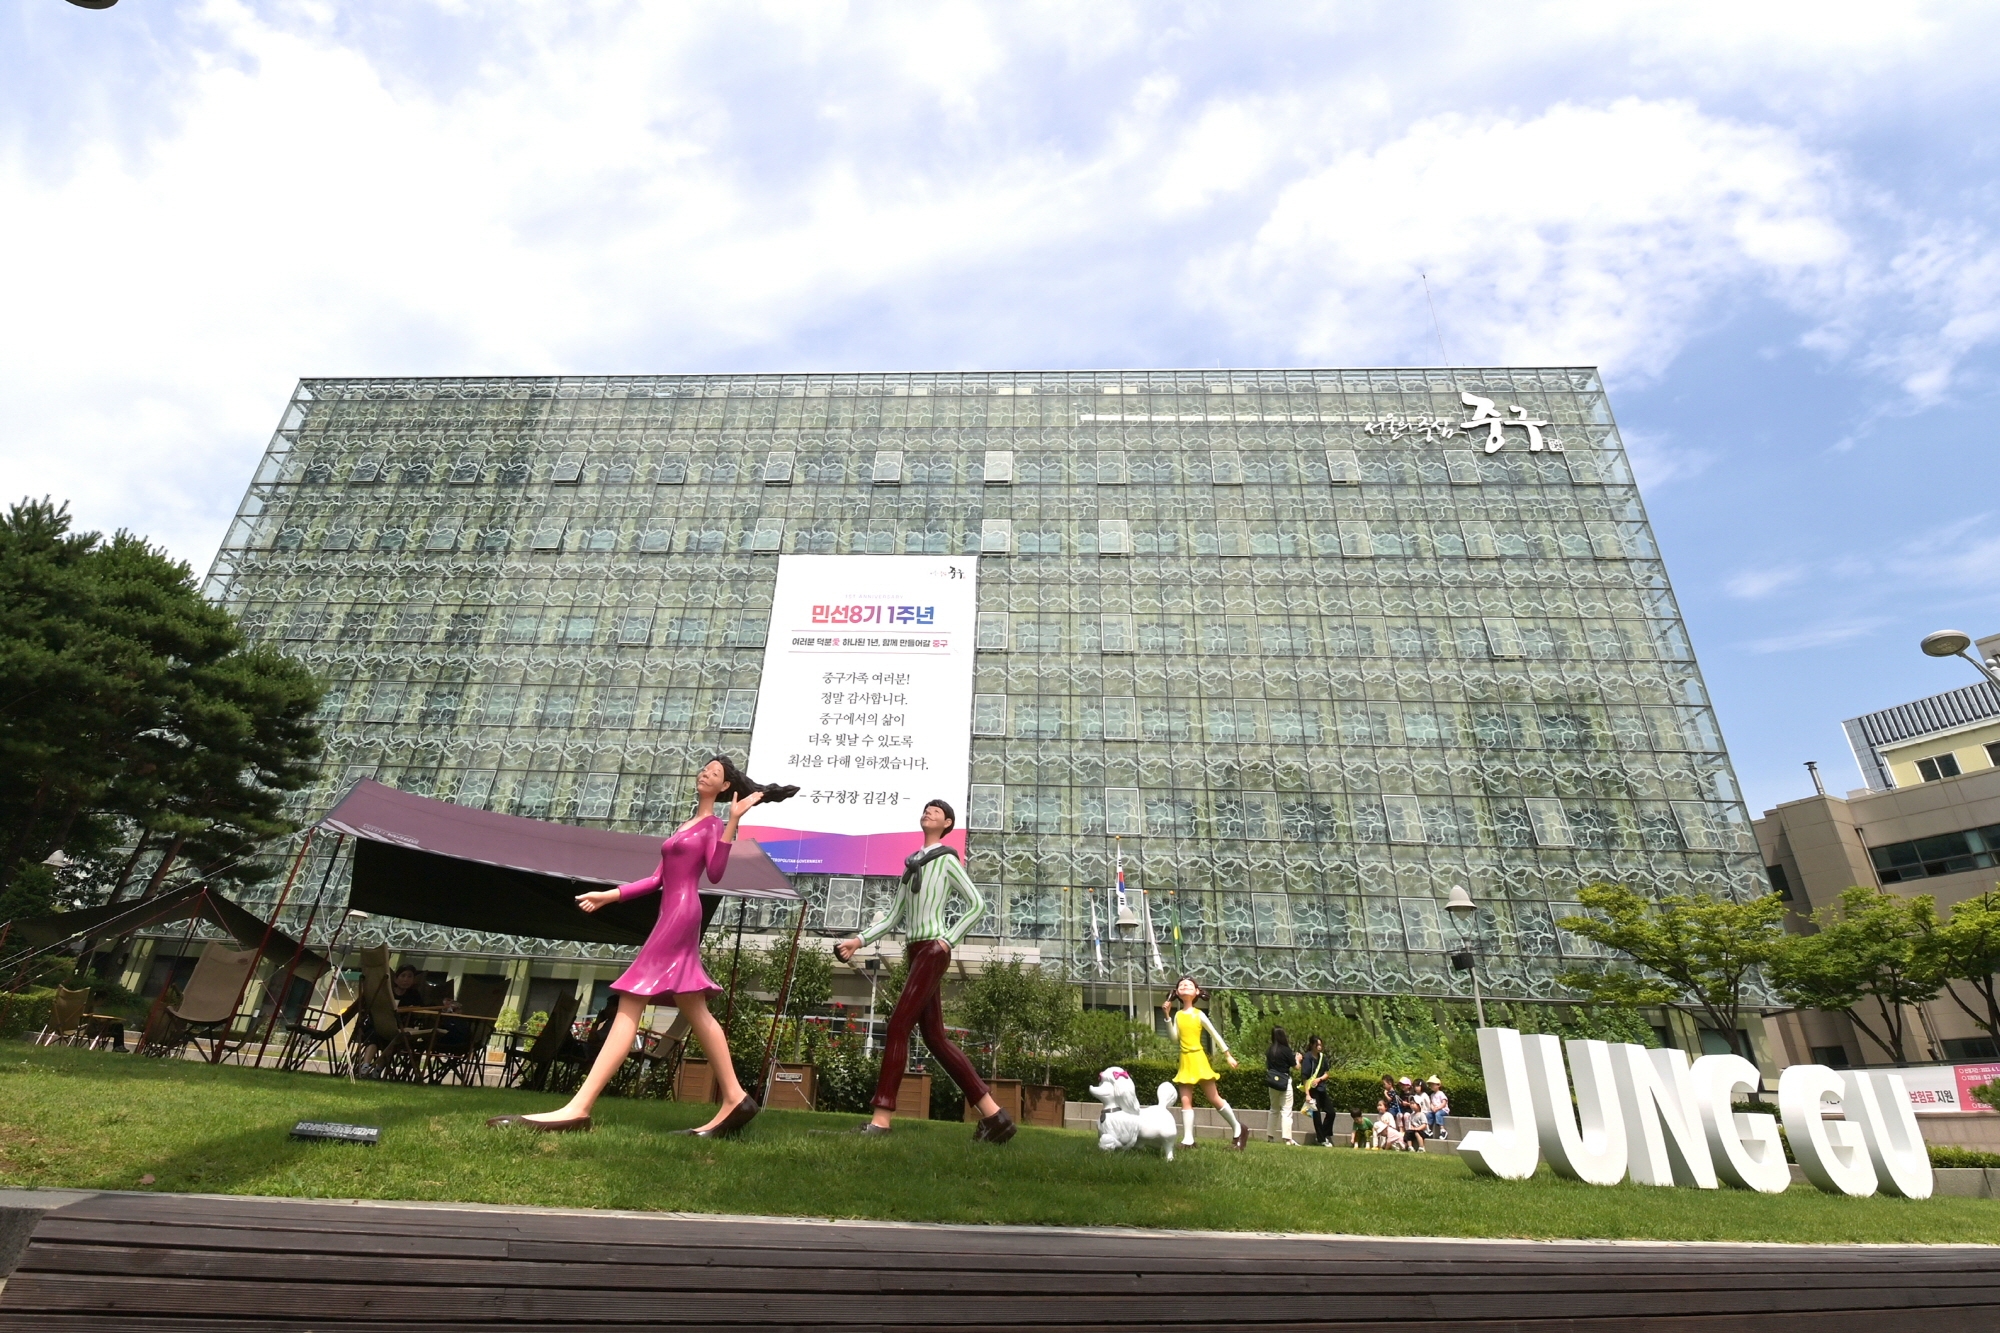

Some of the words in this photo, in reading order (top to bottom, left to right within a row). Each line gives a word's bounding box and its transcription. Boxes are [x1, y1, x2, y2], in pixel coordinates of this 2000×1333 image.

[1460, 392, 1548, 454] 중구
[811, 605, 882, 624] 민선8기
[887, 606, 935, 625] 1주년
[792, 638, 815, 646] 여러분
[842, 638, 866, 647] 하나된
[882, 638, 898, 648] 함께
[900, 638, 931, 648] 만들어갈
[932, 639, 948, 648] 중구
[822, 672, 869, 685] 중구가족
[872, 672, 910, 686] 여러분!
[821, 692, 844, 705] 정말
[847, 692, 908, 706] 감사합니다.
[819, 712, 878, 726] 중구에서의
[881, 713, 905, 726] 삶이
[808, 734, 832, 746] 더욱
[836, 734, 859, 747] 빛날
[862, 734, 874, 747] 수
[878, 734, 913, 748] 있도록
[788, 754, 824, 768] 최선을
[827, 755, 850, 769] 다해
[854, 755, 929, 771] 일하겠습니다.
[810, 790, 860, 804] 중구청장
[863, 792, 900, 806] 김길성
[1935, 1090, 1955, 1103] 지원
